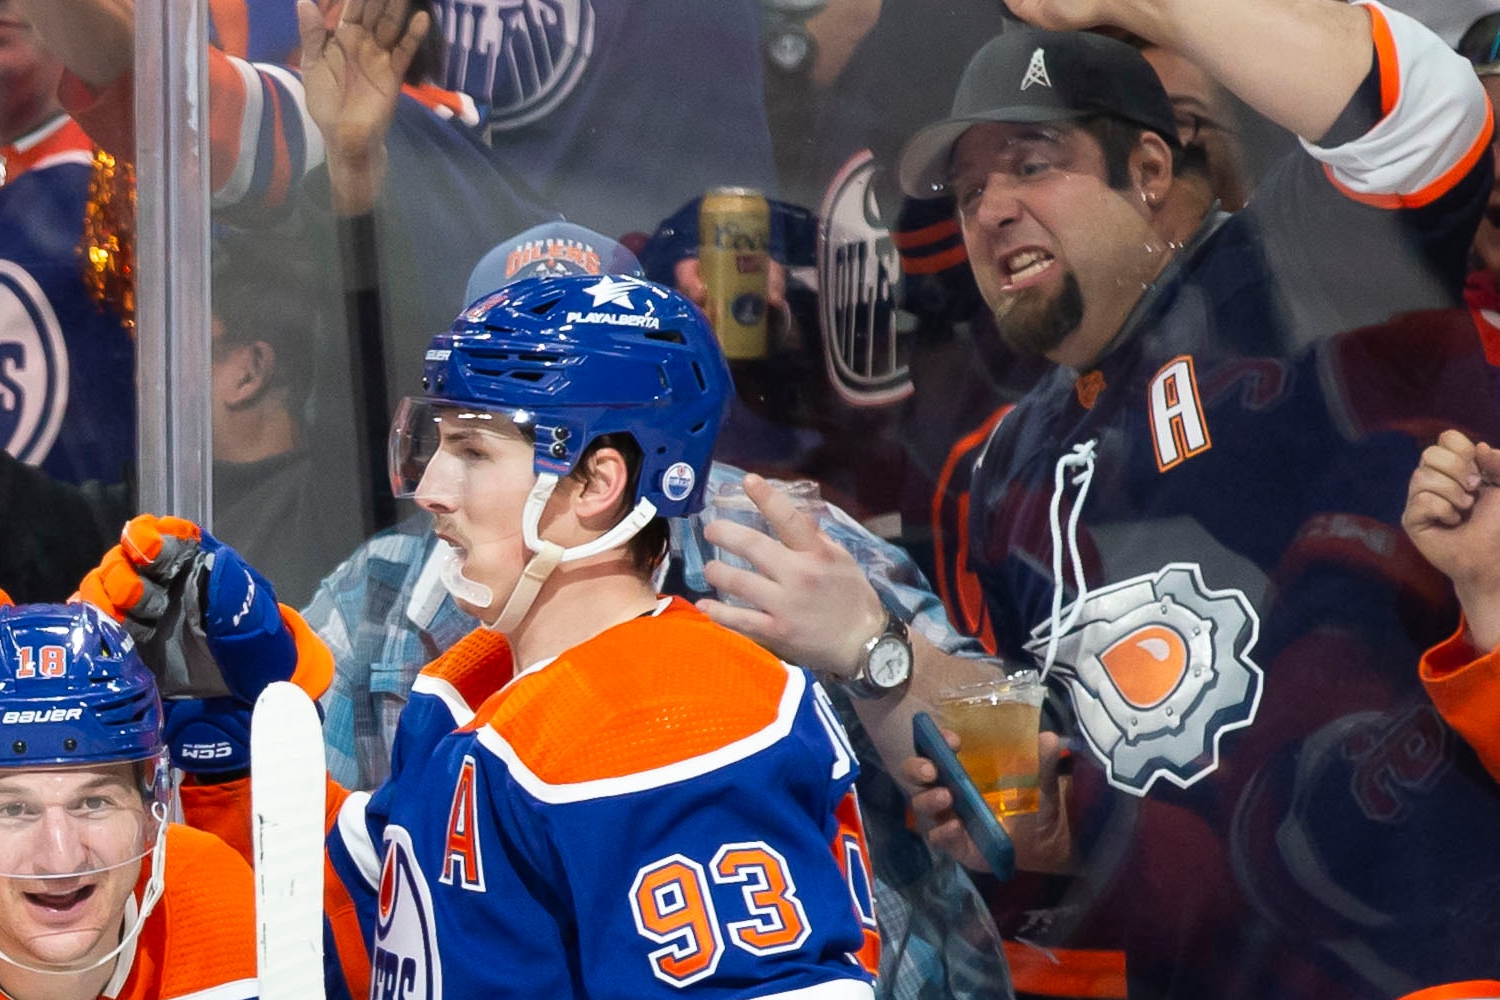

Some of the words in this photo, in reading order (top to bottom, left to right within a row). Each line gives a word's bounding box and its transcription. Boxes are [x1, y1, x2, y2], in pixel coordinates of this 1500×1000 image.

[566, 311, 661, 330] PLAYALBERTA
[1147, 354, 1213, 474] A
[16, 645, 67, 680] 18
[2, 708, 83, 725] BAUER
[181, 746, 233, 760] CCM
[438, 753, 487, 893] A
[628, 840, 817, 989] 93
